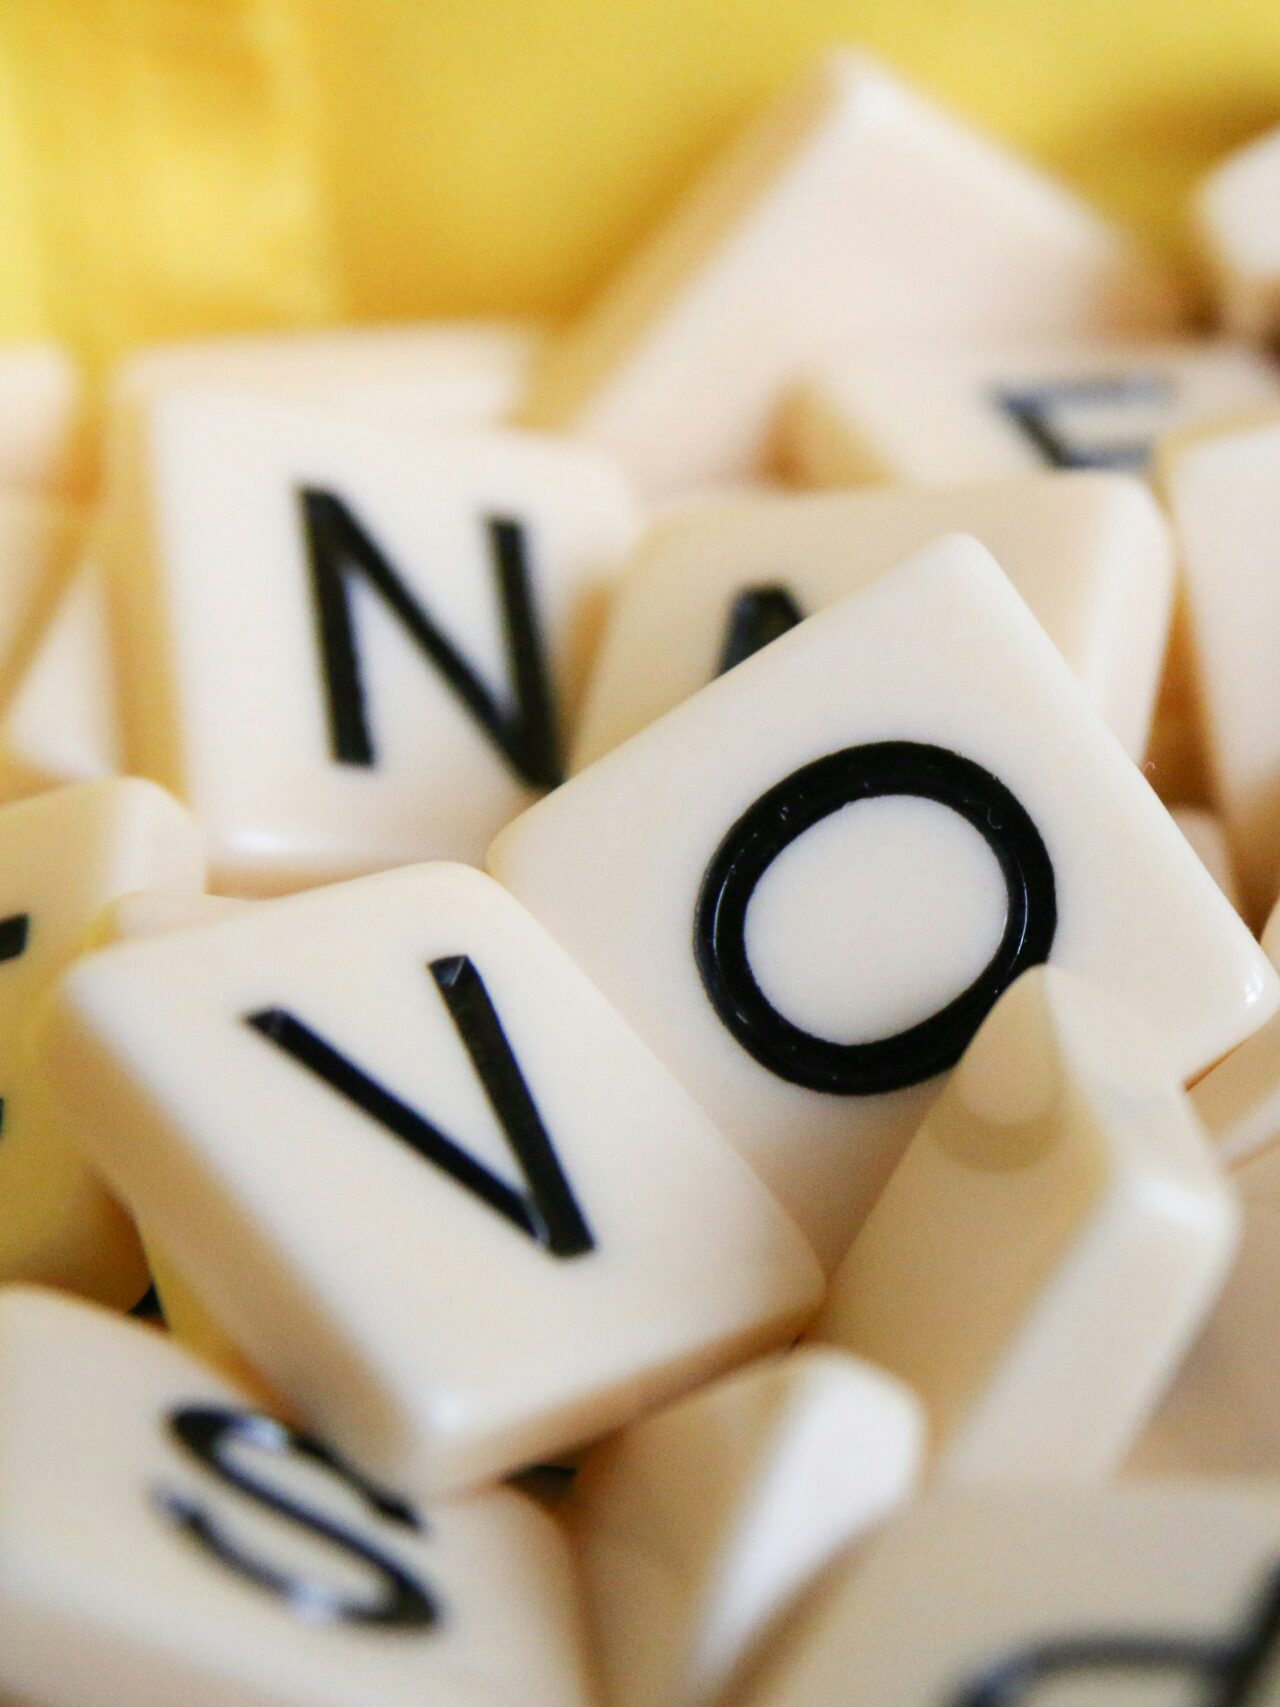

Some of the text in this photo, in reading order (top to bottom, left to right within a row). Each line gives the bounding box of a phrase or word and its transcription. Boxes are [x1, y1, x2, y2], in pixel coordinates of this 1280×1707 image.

[302, 488, 573, 792] N
[694, 741, 1058, 1098] O
[246, 955, 595, 1259] V
[155, 1403, 442, 1632] S
